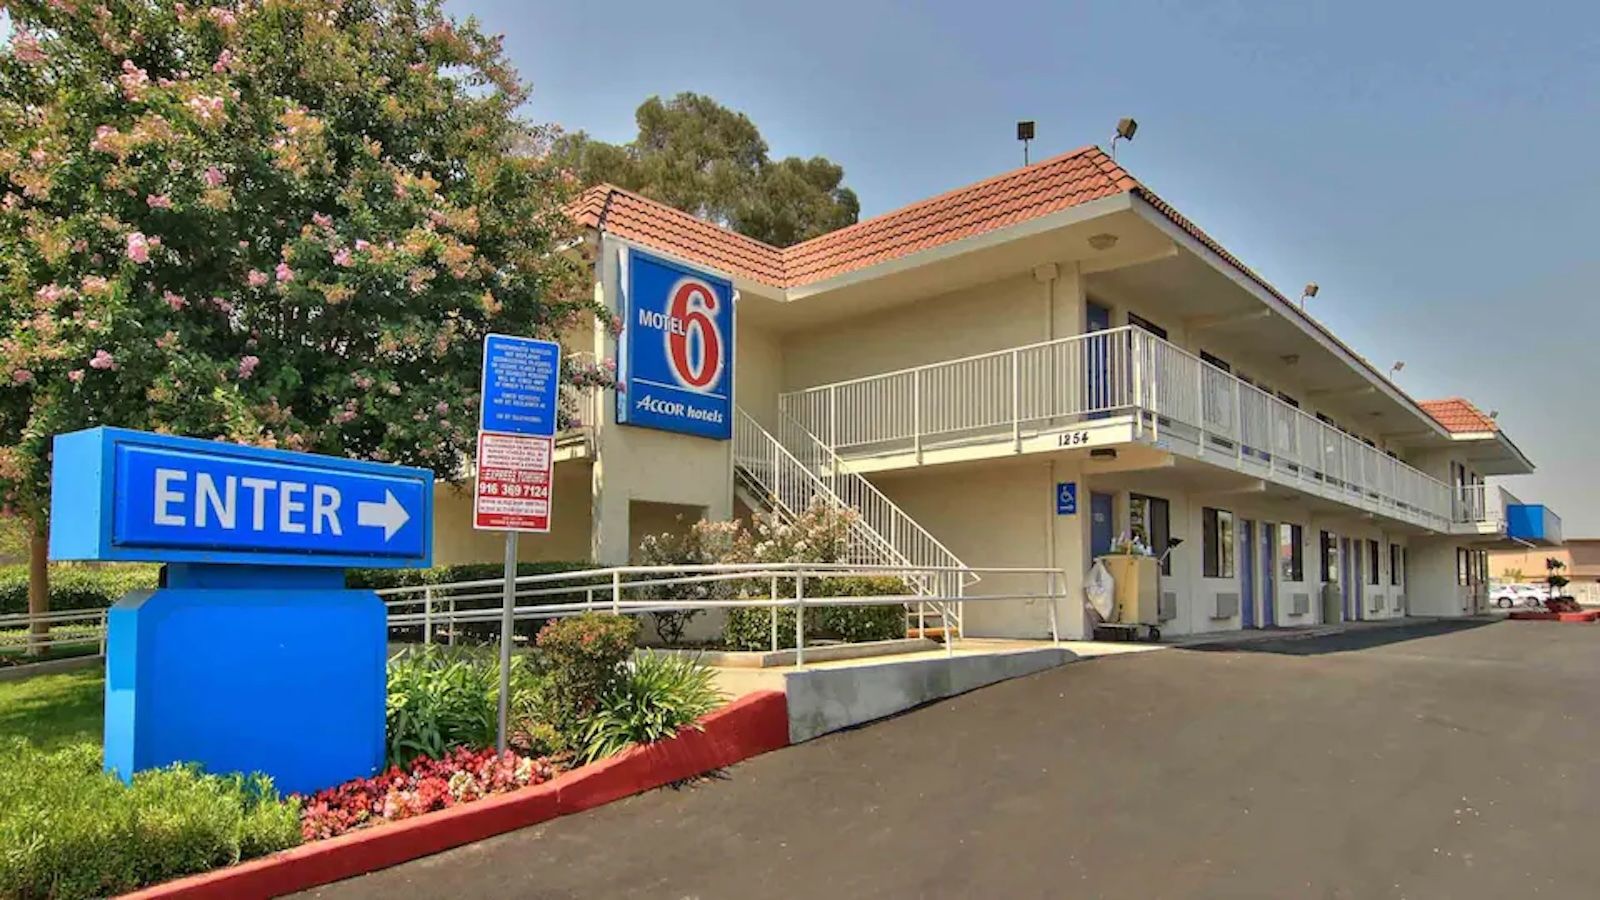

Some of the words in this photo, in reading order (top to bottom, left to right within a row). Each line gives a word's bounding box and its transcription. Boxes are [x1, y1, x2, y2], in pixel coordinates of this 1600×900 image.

[638, 309, 685, 336] MOTEL
[667, 280, 722, 390] 6
[636, 395, 685, 417] ACCOR
[687, 406, 723, 424] hotels
[1059, 432, 1088, 446] 1254
[154, 468, 343, 536] ENTER
[480, 482, 498, 495] 916
[502, 485, 521, 497] 369
[524, 486, 548, 498] 7124
